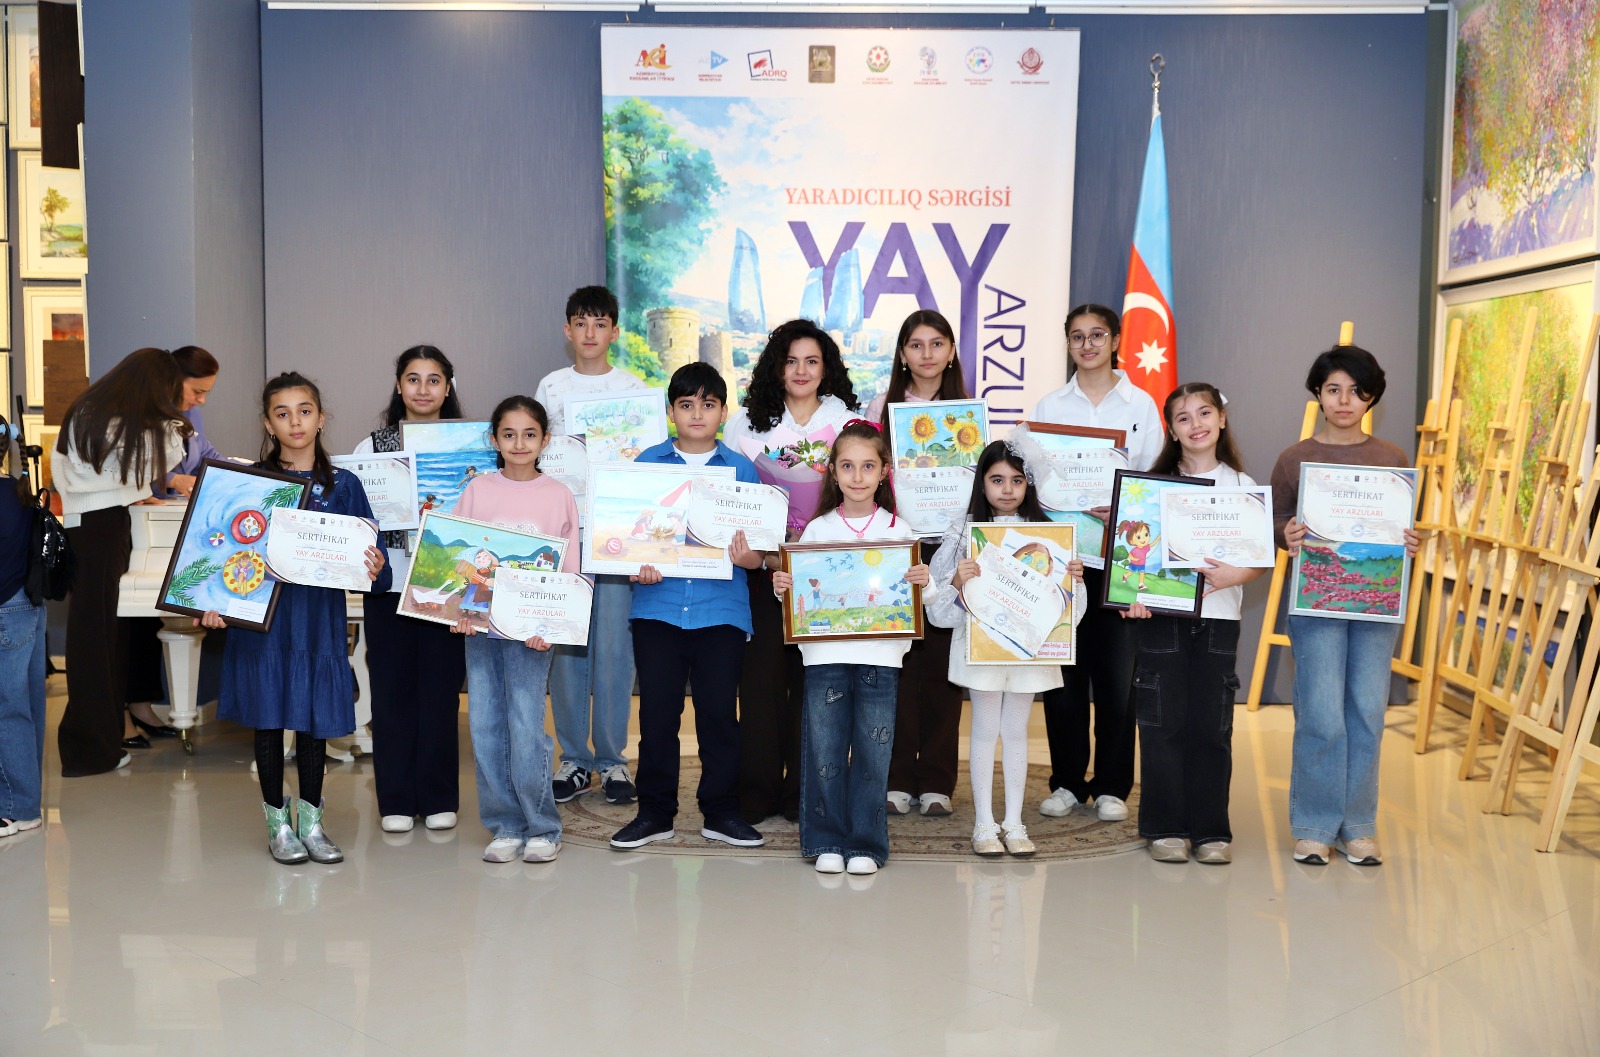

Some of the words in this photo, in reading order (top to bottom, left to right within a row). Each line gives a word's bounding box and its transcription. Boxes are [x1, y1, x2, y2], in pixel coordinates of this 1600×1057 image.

[761, 69, 788, 78] ADRQ
[784, 187, 923, 211] YARADICILIQ
[927, 185, 1012, 208] SƏRGİSİ
[787, 220, 1012, 400] YAY
[1063, 465, 1104, 474] ERTİFİKAT
[1331, 488, 1385, 501] SERTİFİKAT
[929, 500, 961, 508] ARZULARI
[1191, 511, 1241, 521] SERTİFİKAT
[1346, 508, 1384, 517] ARZULARI
[727, 517, 762, 526] ARZULARI
[295, 549, 309, 557] YAY
[310, 551, 347, 562] ARZULARI
[995, 573, 1041, 604] SERTİFİKAT
[987, 588, 1001, 599] YAY
[999, 597, 1031, 618] ARZULARI
[517, 607, 530, 615] YAY
[532, 609, 566, 617] ARZULARI
